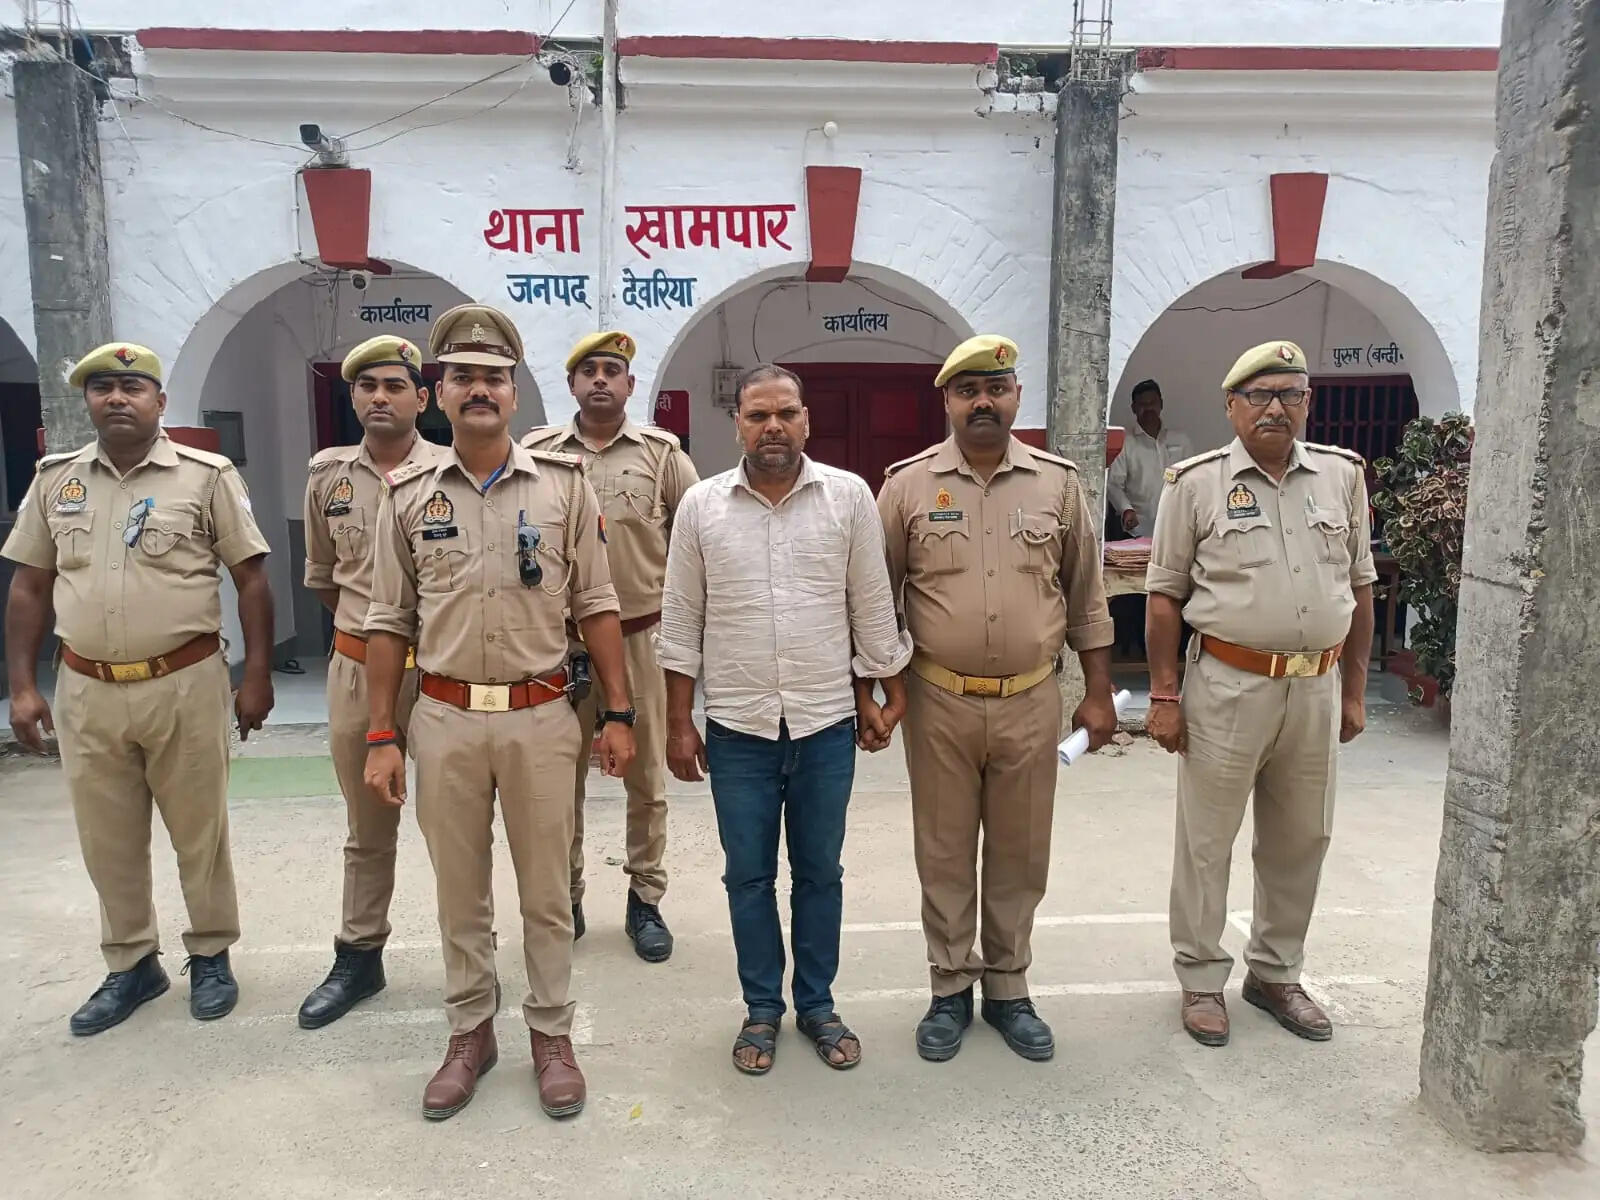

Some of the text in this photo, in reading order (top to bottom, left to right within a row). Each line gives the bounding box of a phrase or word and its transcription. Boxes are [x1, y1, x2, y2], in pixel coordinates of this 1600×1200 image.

[483, 204, 796, 259] थाना खामपार
[506, 267, 698, 311] जनपद देवरिया
[359, 297, 433, 325] कार्यालय
[822, 306, 890, 334] कार्यालय
